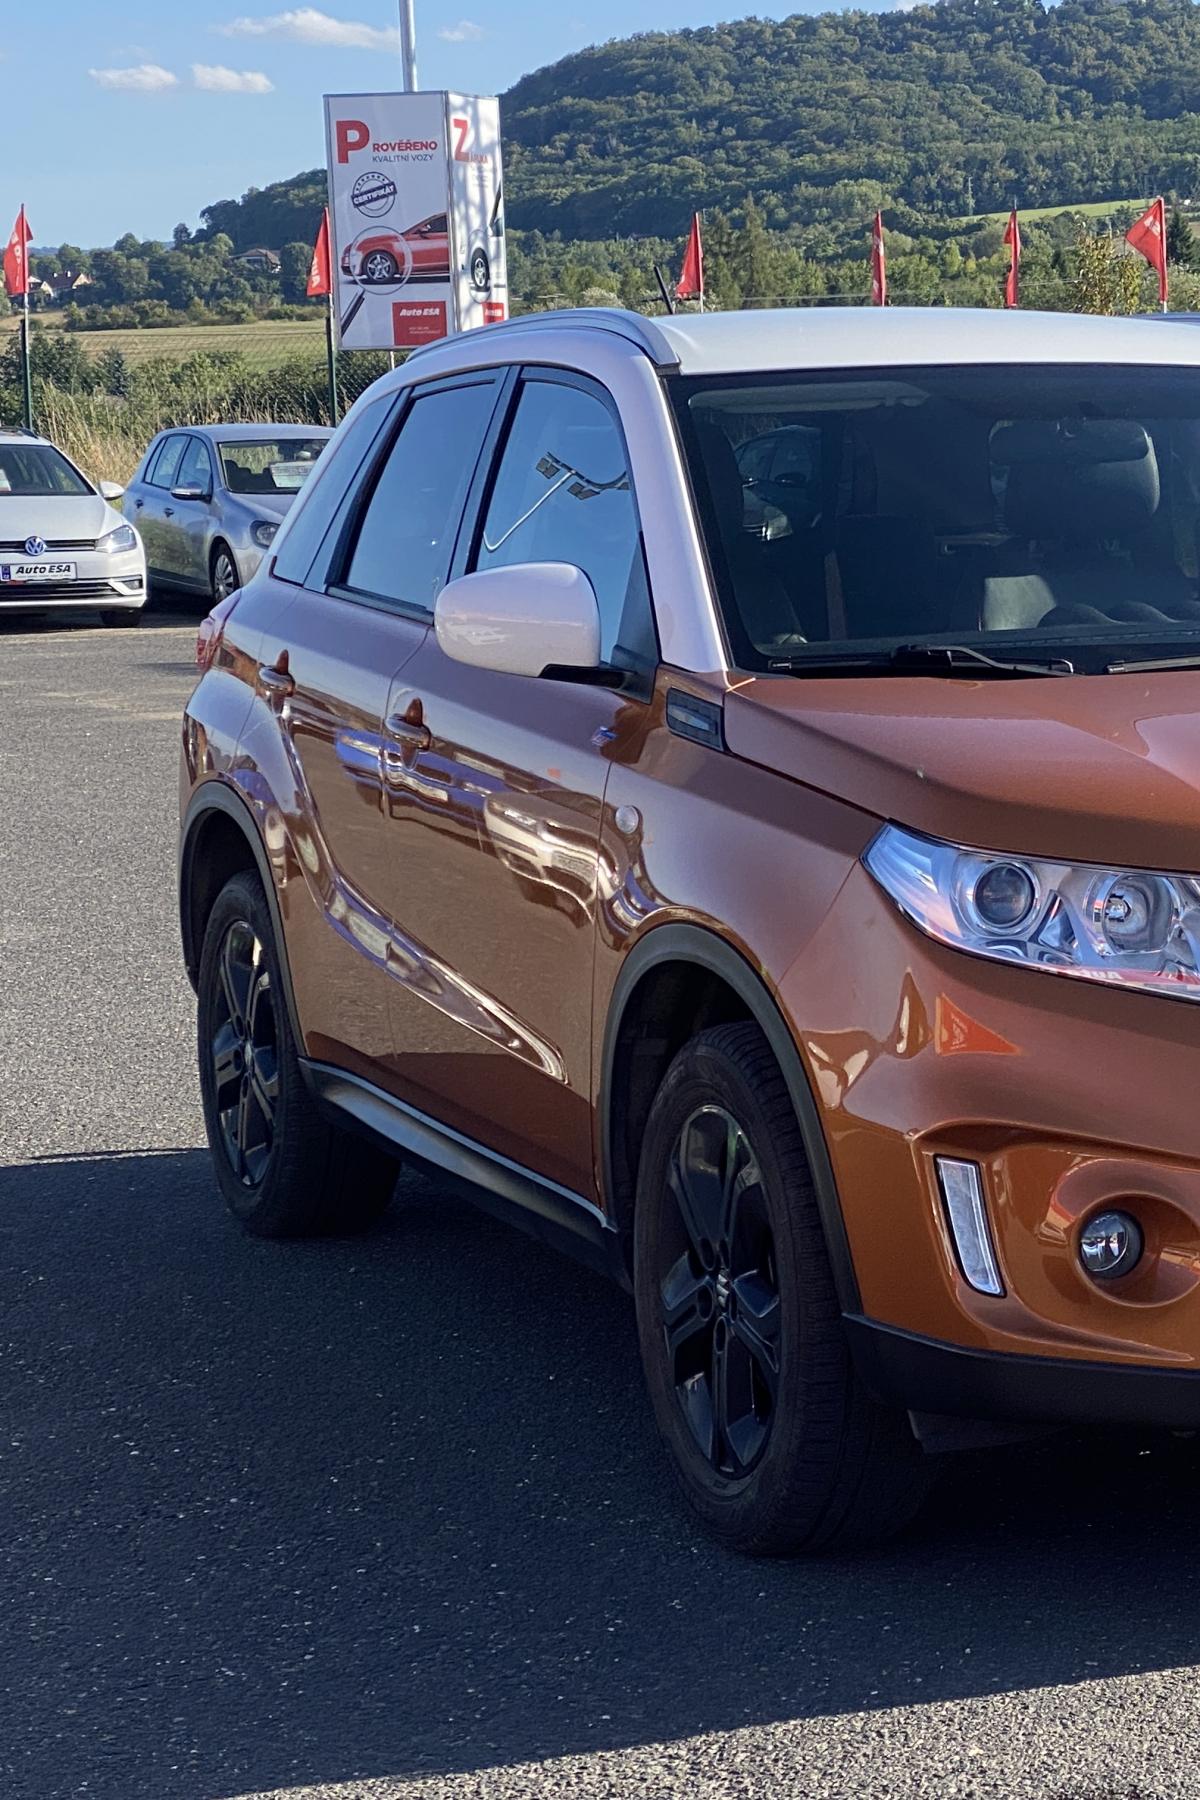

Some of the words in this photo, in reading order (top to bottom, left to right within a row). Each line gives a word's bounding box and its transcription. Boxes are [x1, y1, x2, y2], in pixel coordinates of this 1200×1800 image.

[372, 153, 410, 163] KVALITNÍ
[411, 153, 434, 162] VOZY
[400, 308, 422, 317] Auto
[423, 307, 440, 316] ESA
[16, 564, 47, 575] Auto
[48, 564, 71, 574] ESA
